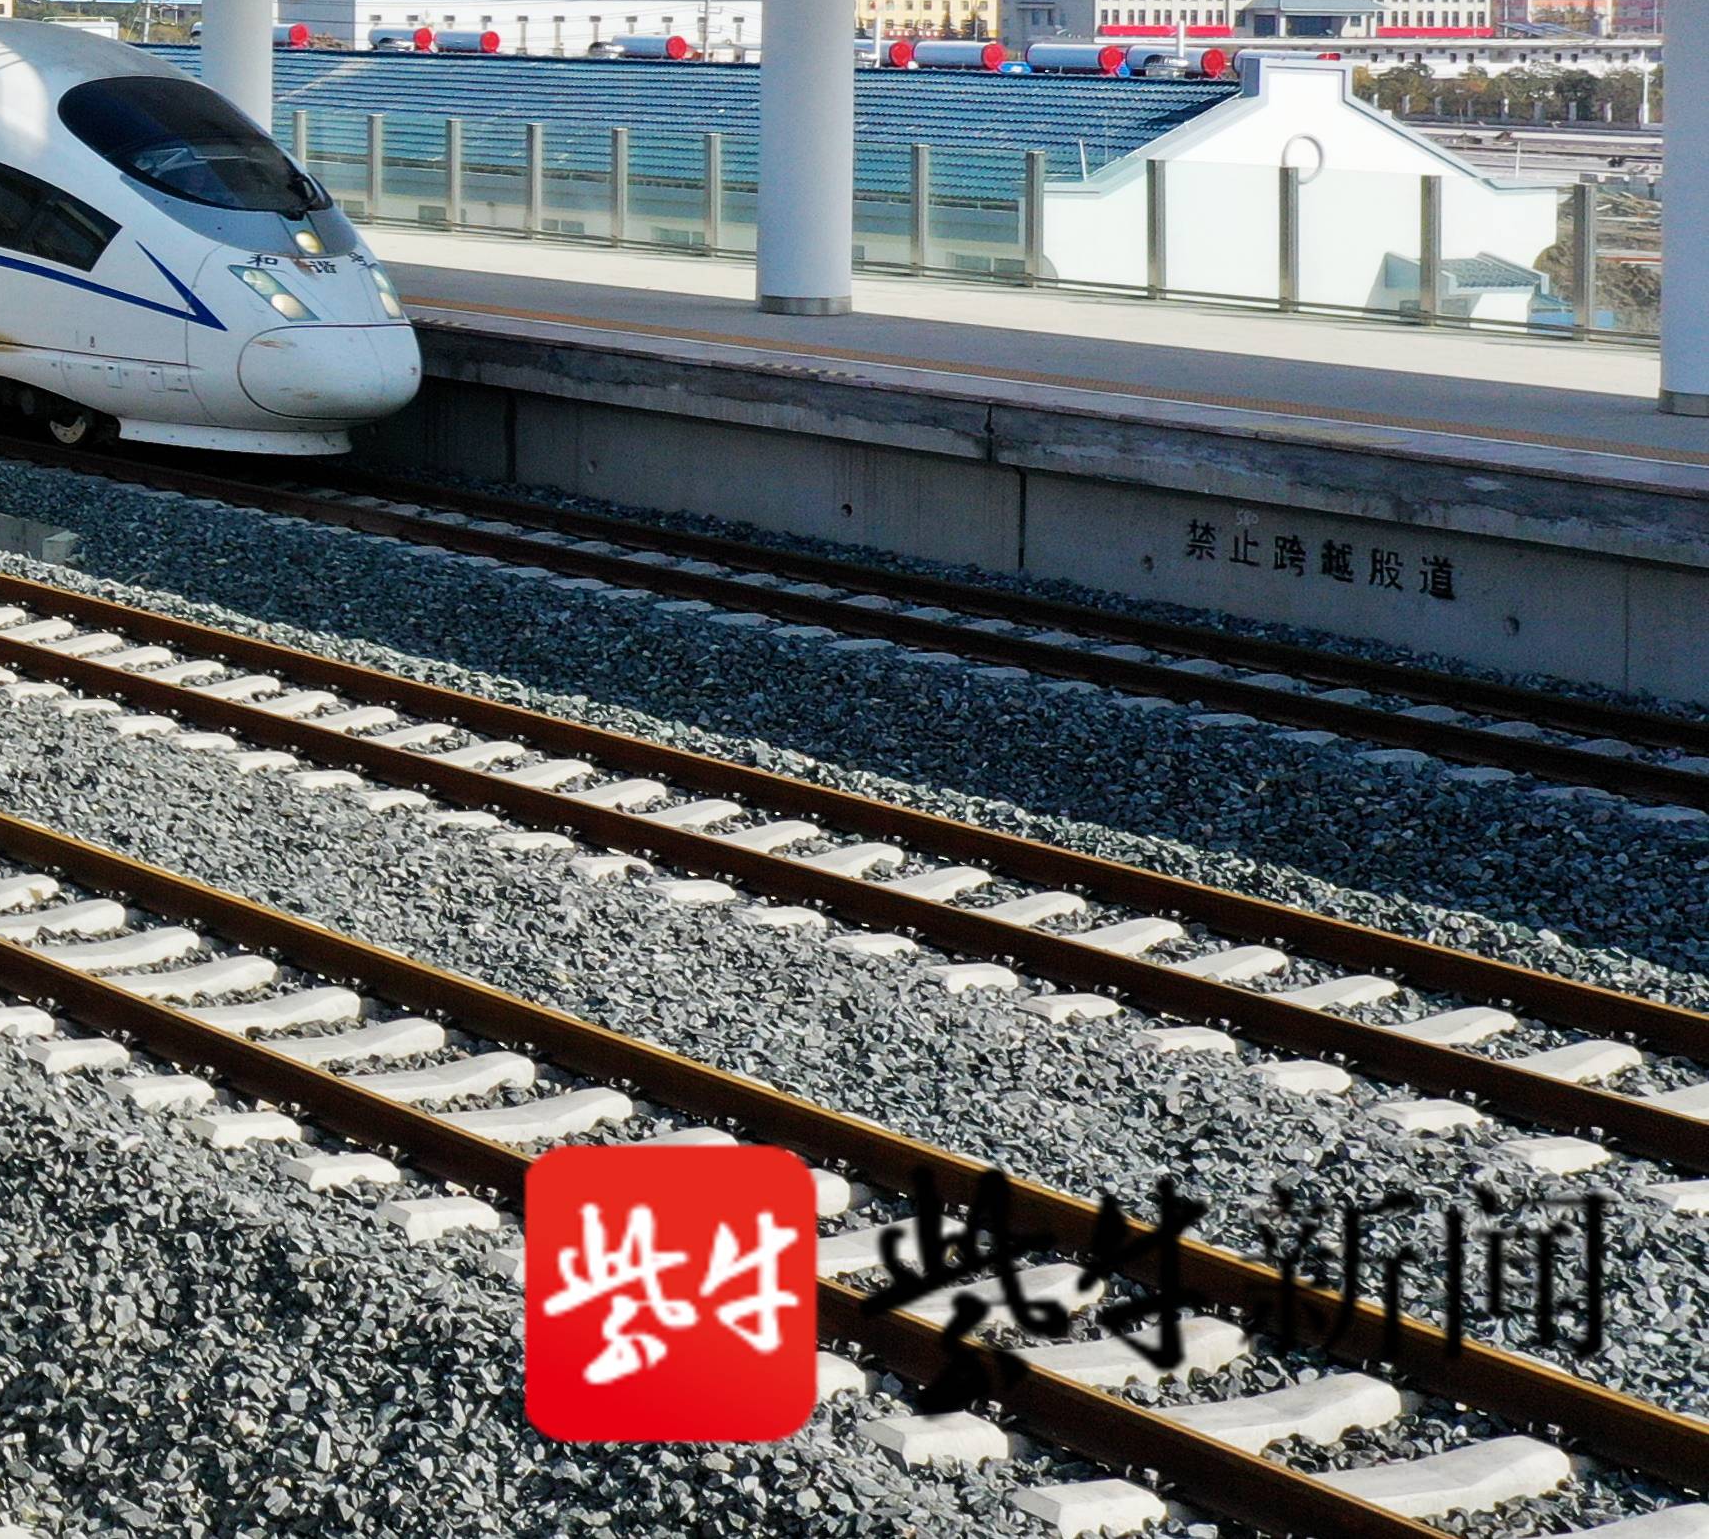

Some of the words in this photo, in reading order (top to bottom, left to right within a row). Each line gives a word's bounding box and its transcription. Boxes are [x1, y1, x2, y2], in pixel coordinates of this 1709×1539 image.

[1185, 518, 1457, 601] 禁止跨越股道
